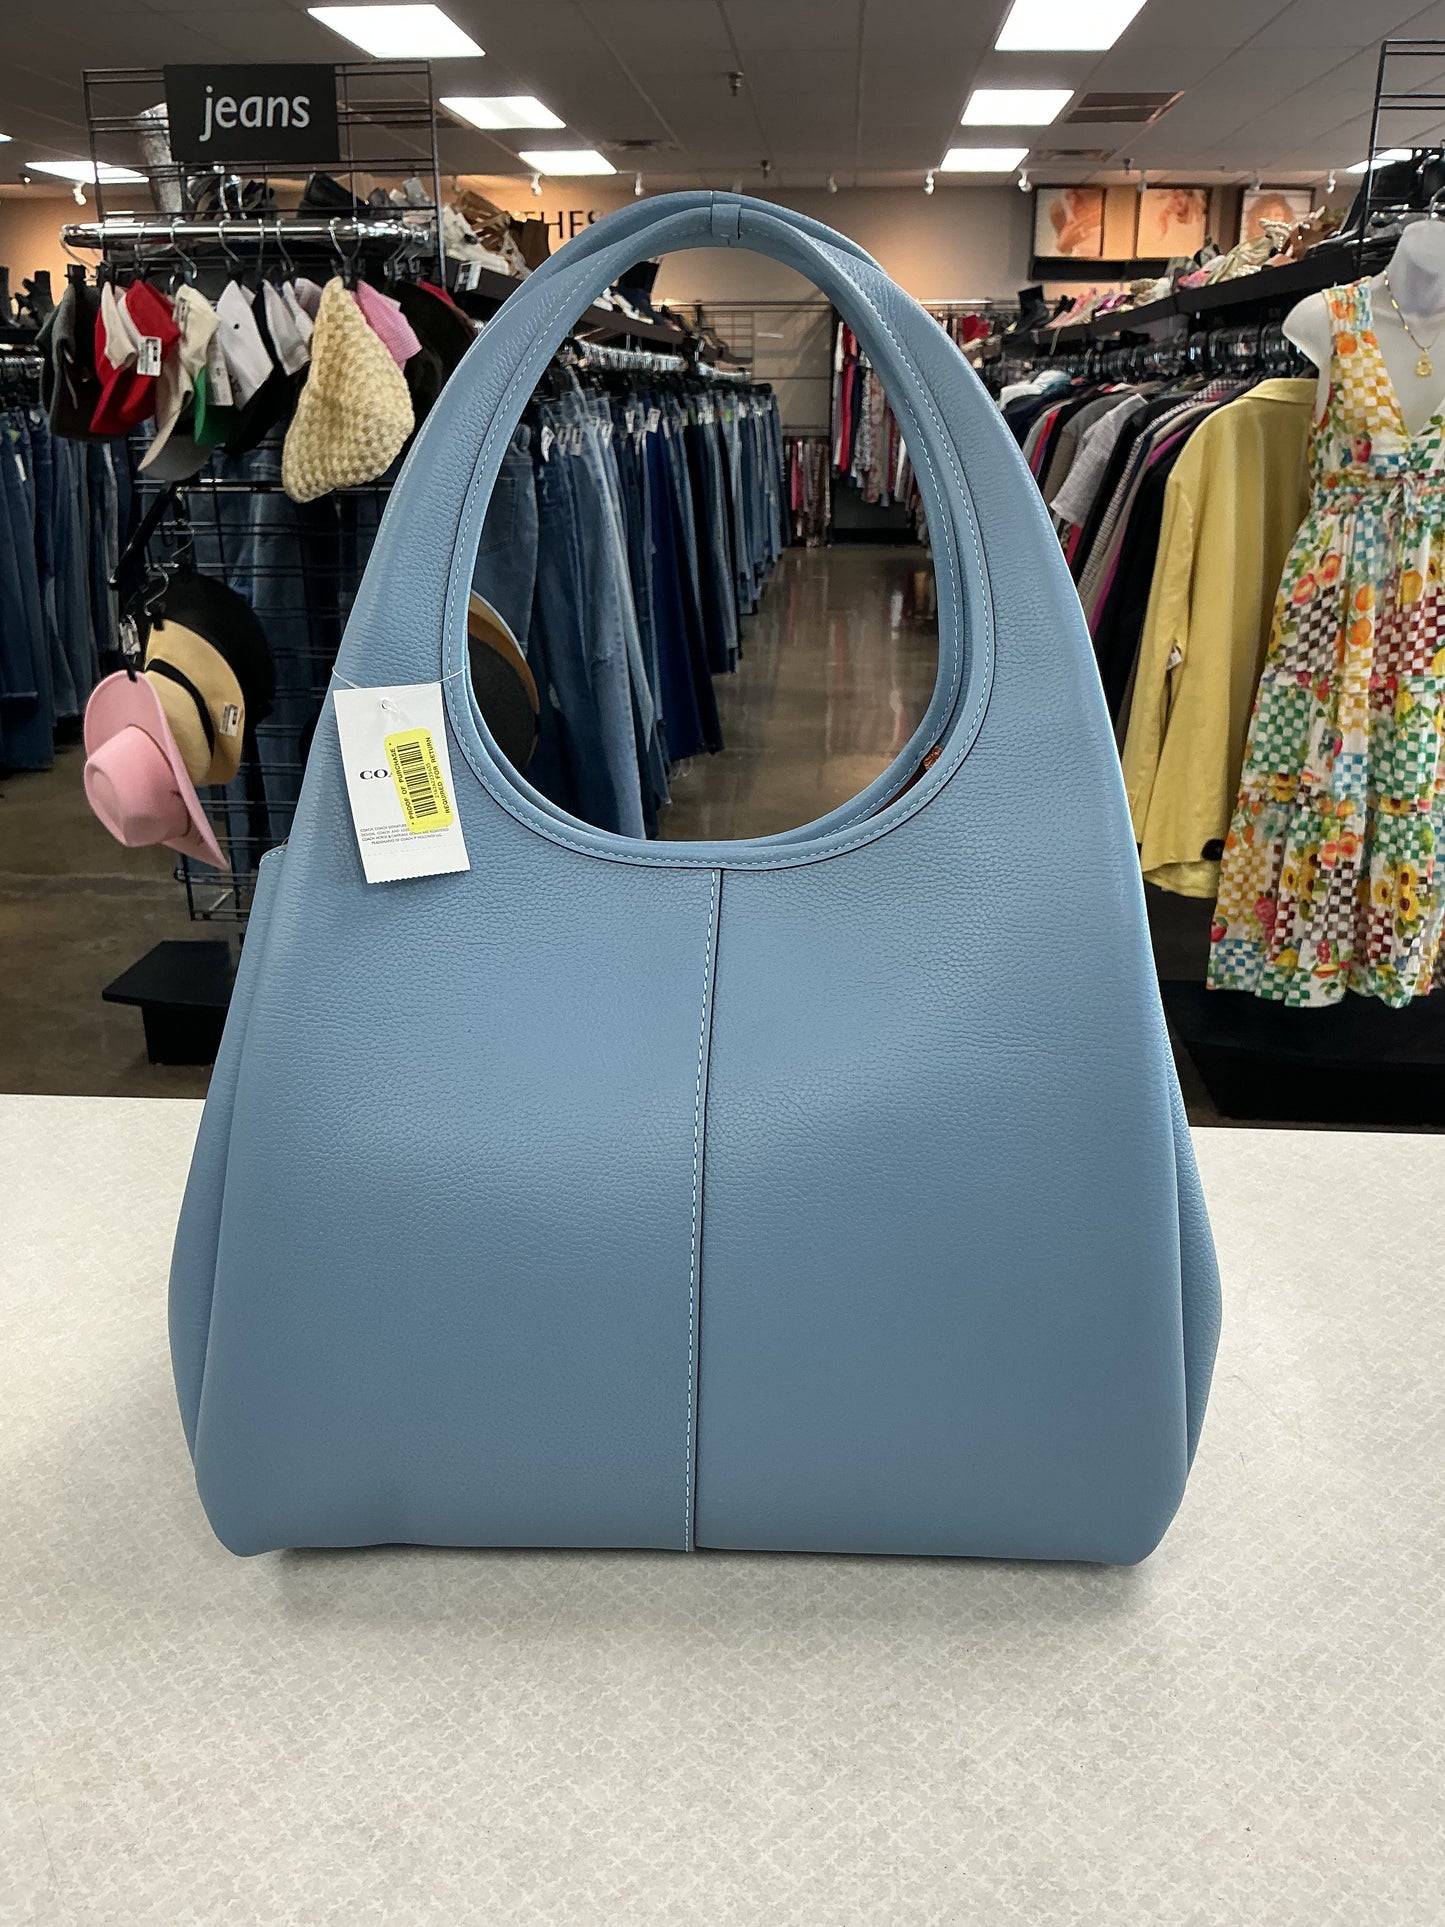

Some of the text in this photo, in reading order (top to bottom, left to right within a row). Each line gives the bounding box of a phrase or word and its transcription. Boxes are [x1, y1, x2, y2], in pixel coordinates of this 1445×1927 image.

[198, 85, 311, 142] jeans
[390, 748, 415, 820] PROOF OF PURCHASE
[425, 737, 450, 814] REQUIRED FOR RETURN
